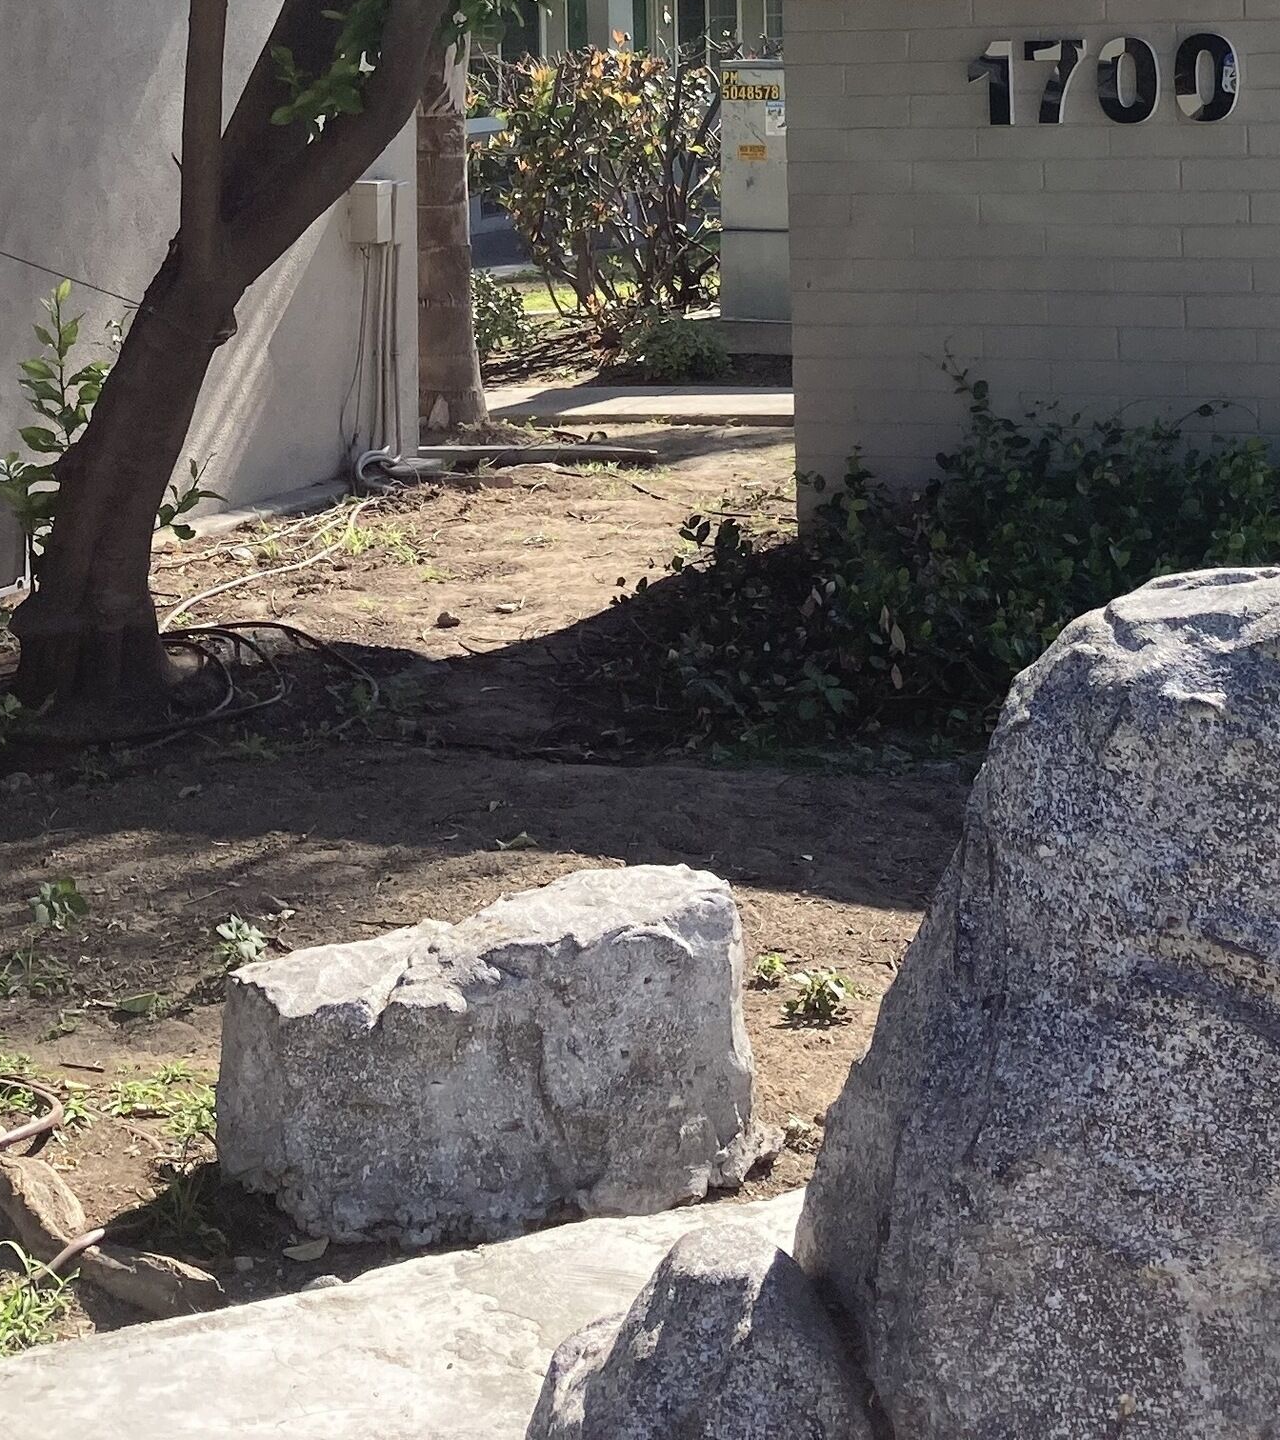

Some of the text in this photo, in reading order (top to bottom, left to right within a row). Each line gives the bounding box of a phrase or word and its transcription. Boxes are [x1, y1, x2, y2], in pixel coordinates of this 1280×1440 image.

[722, 71, 738, 85] PM
[966, 32, 1239, 127] 1700
[722, 86, 779, 100] 5048578
